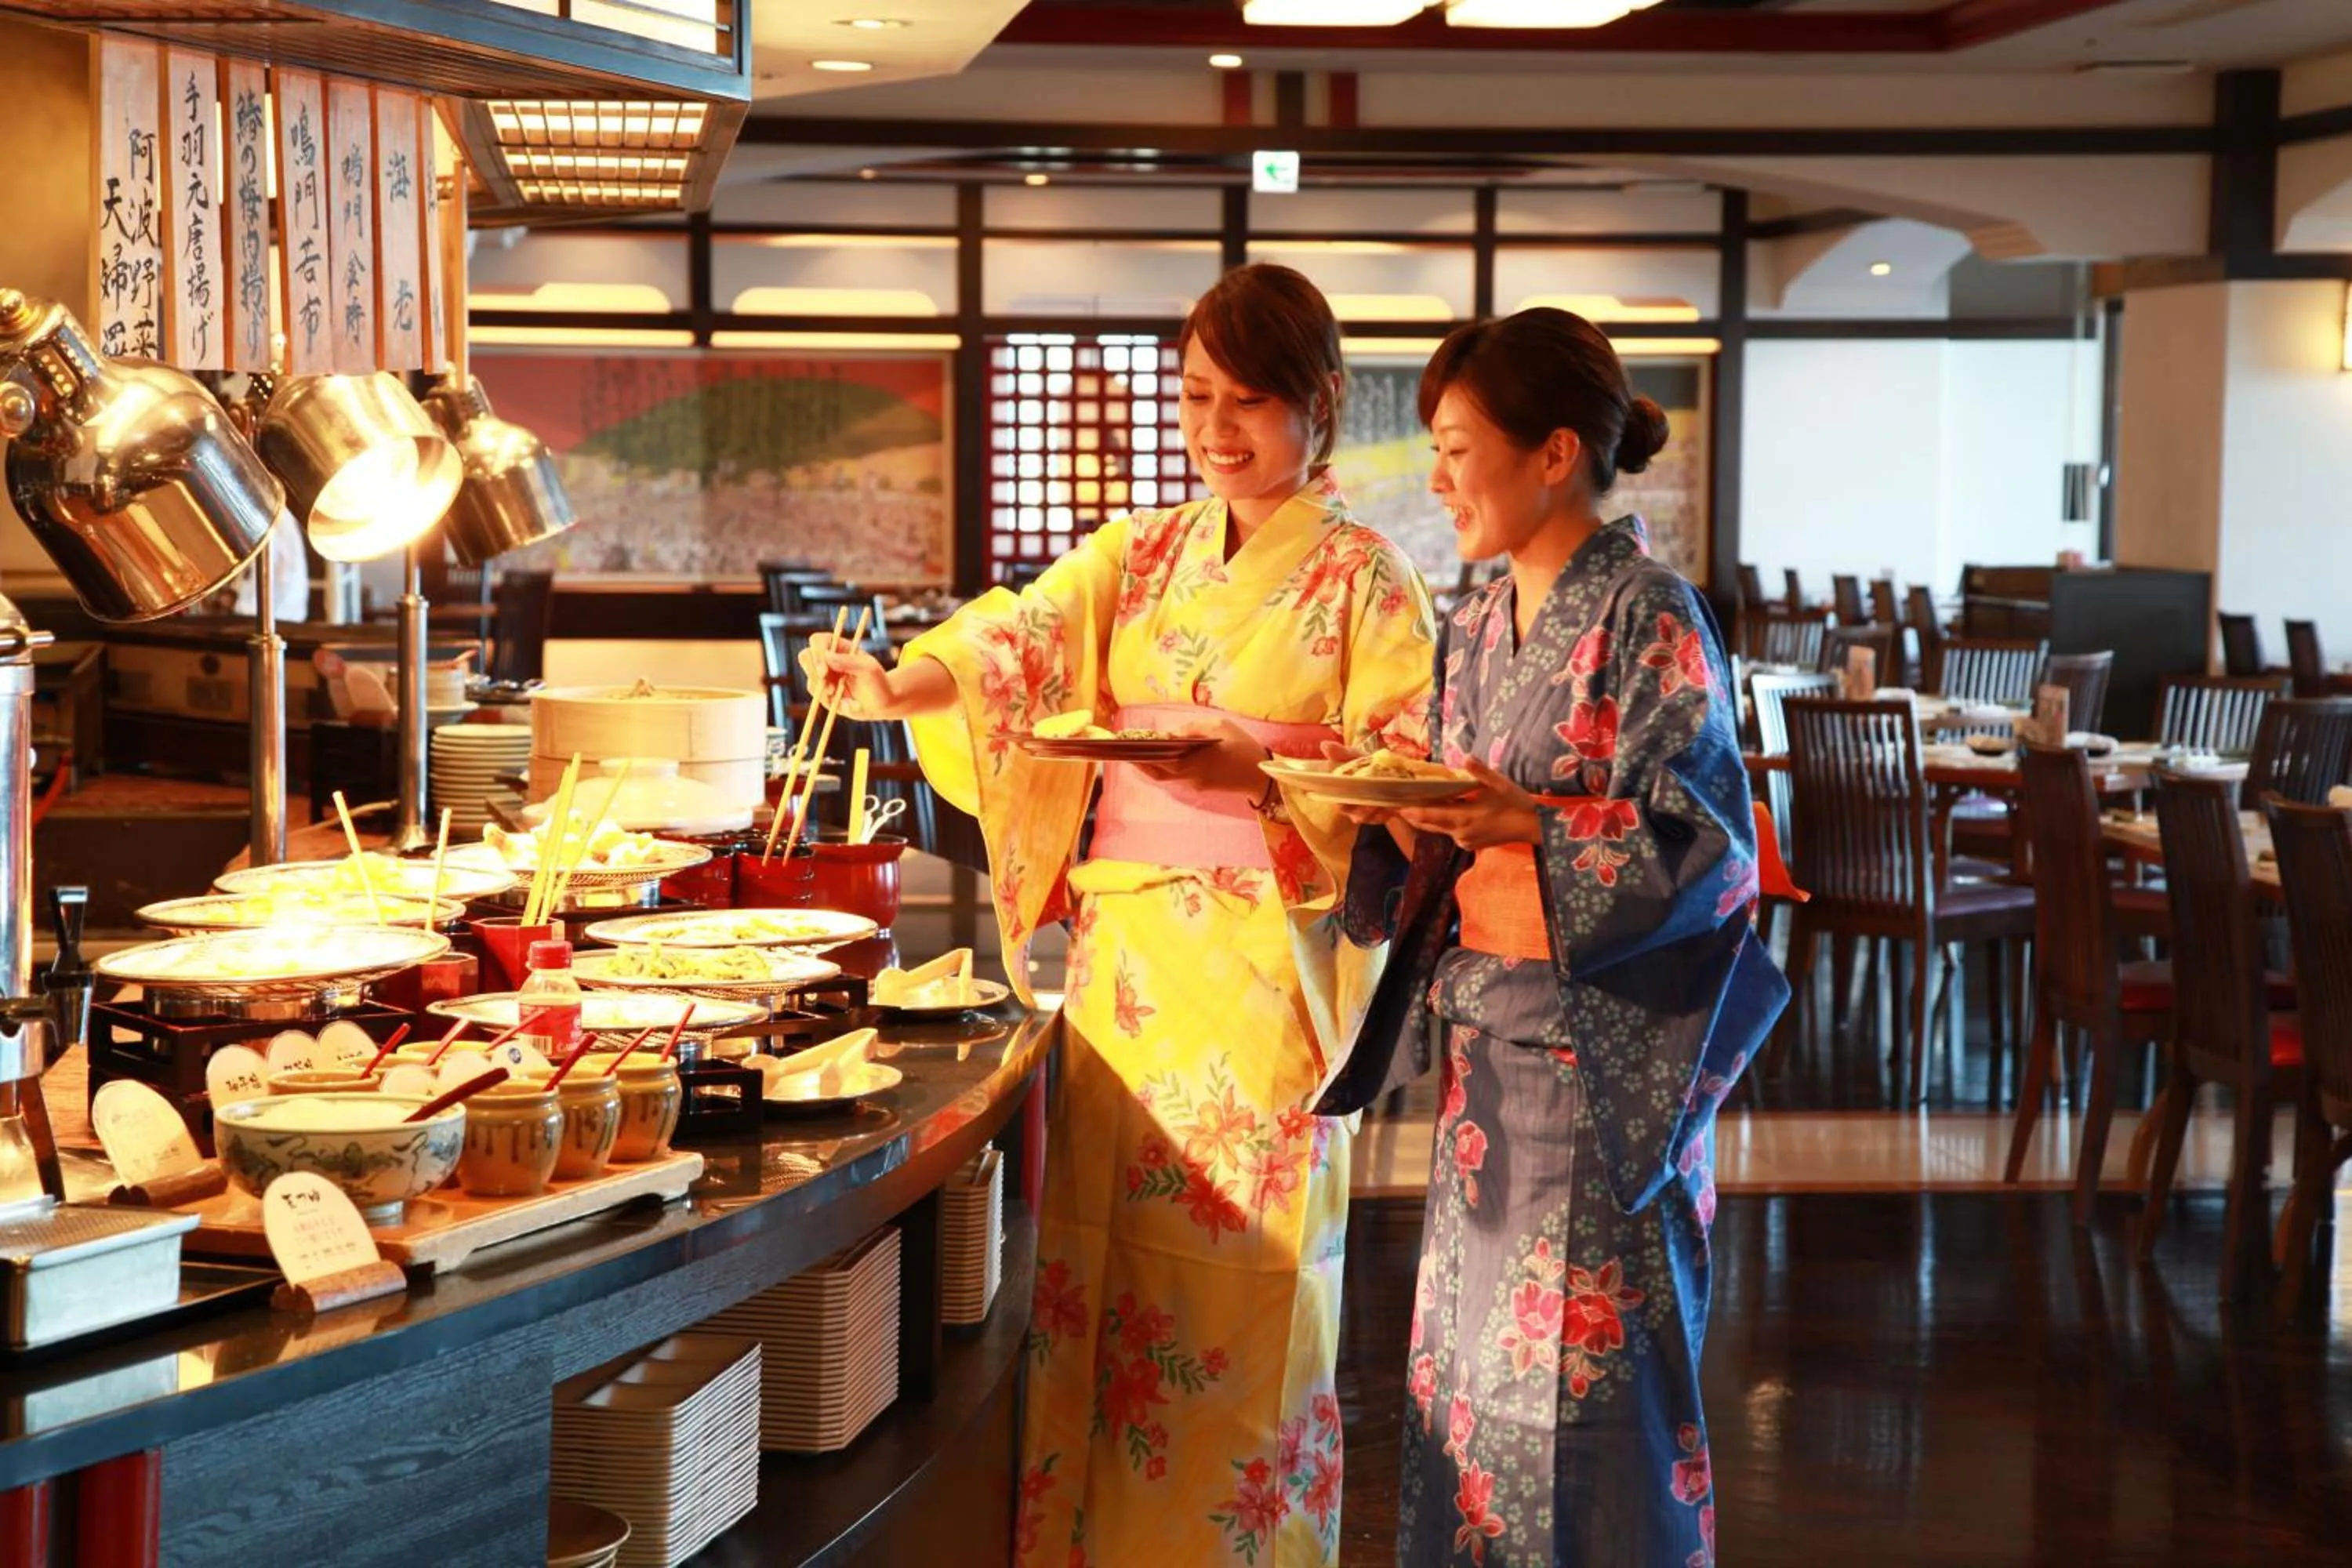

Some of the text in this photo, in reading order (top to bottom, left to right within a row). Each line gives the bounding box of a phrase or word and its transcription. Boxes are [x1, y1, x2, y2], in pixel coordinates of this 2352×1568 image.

[126, 129, 157, 358] 阿波野菜
[181, 71, 213, 361] 手羽元唐揚げ
[386, 151, 414, 332] 海老
